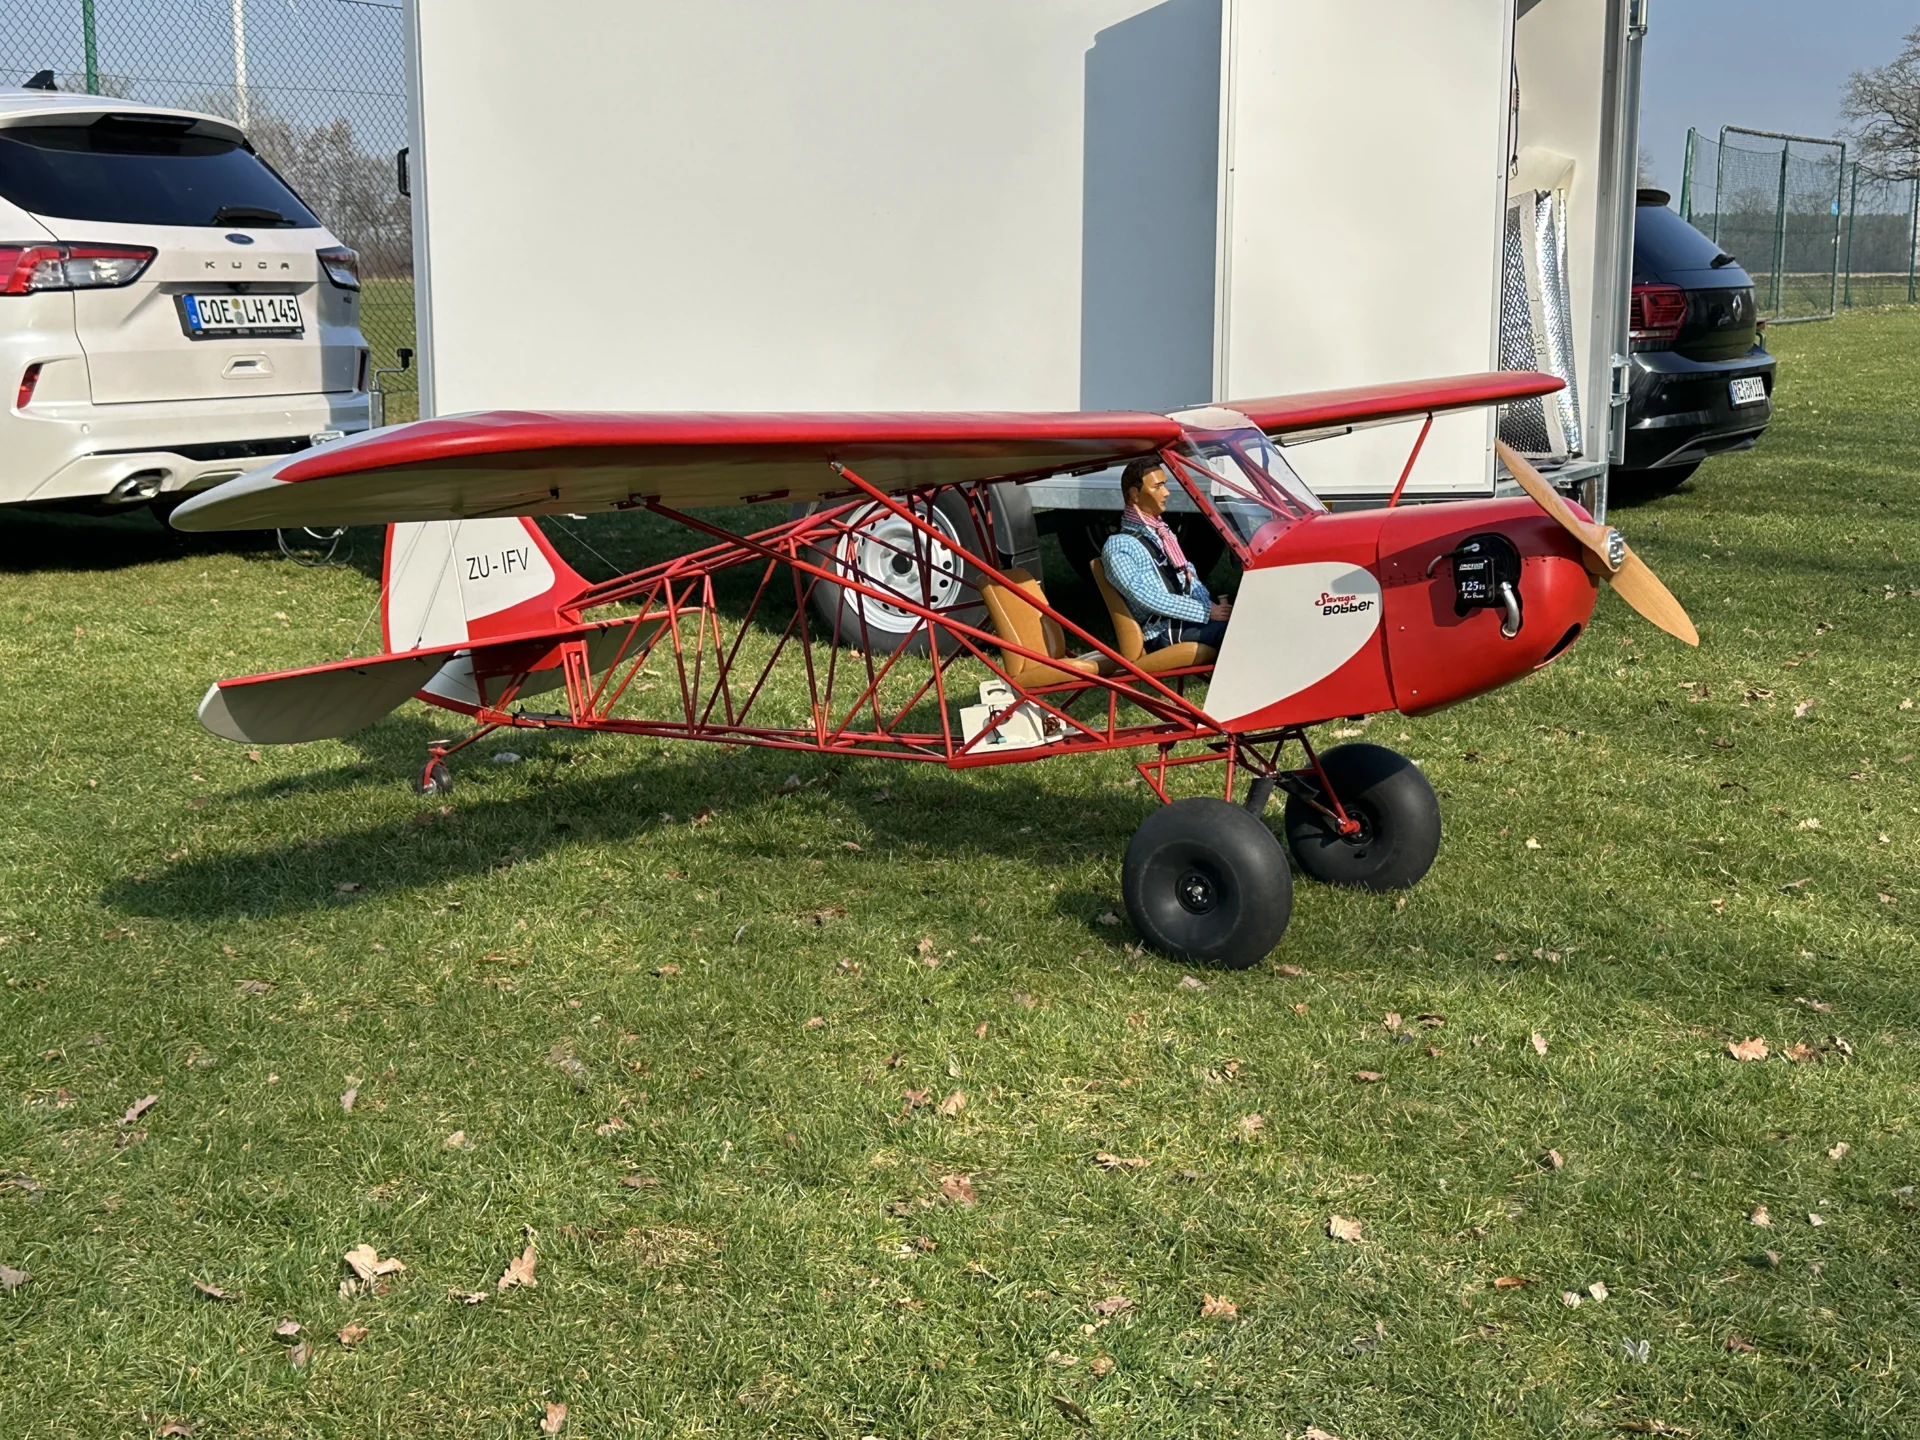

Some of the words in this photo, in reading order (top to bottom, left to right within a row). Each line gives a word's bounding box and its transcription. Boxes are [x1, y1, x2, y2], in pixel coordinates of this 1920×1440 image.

[205, 261, 290, 269] KUGA
[198, 299, 235, 325] COE
[242, 299, 268, 323] LH
[268, 299, 298, 323] 145
[466, 547, 528, 580] ZU-IFV
[1315, 592, 1357, 606] Savage
